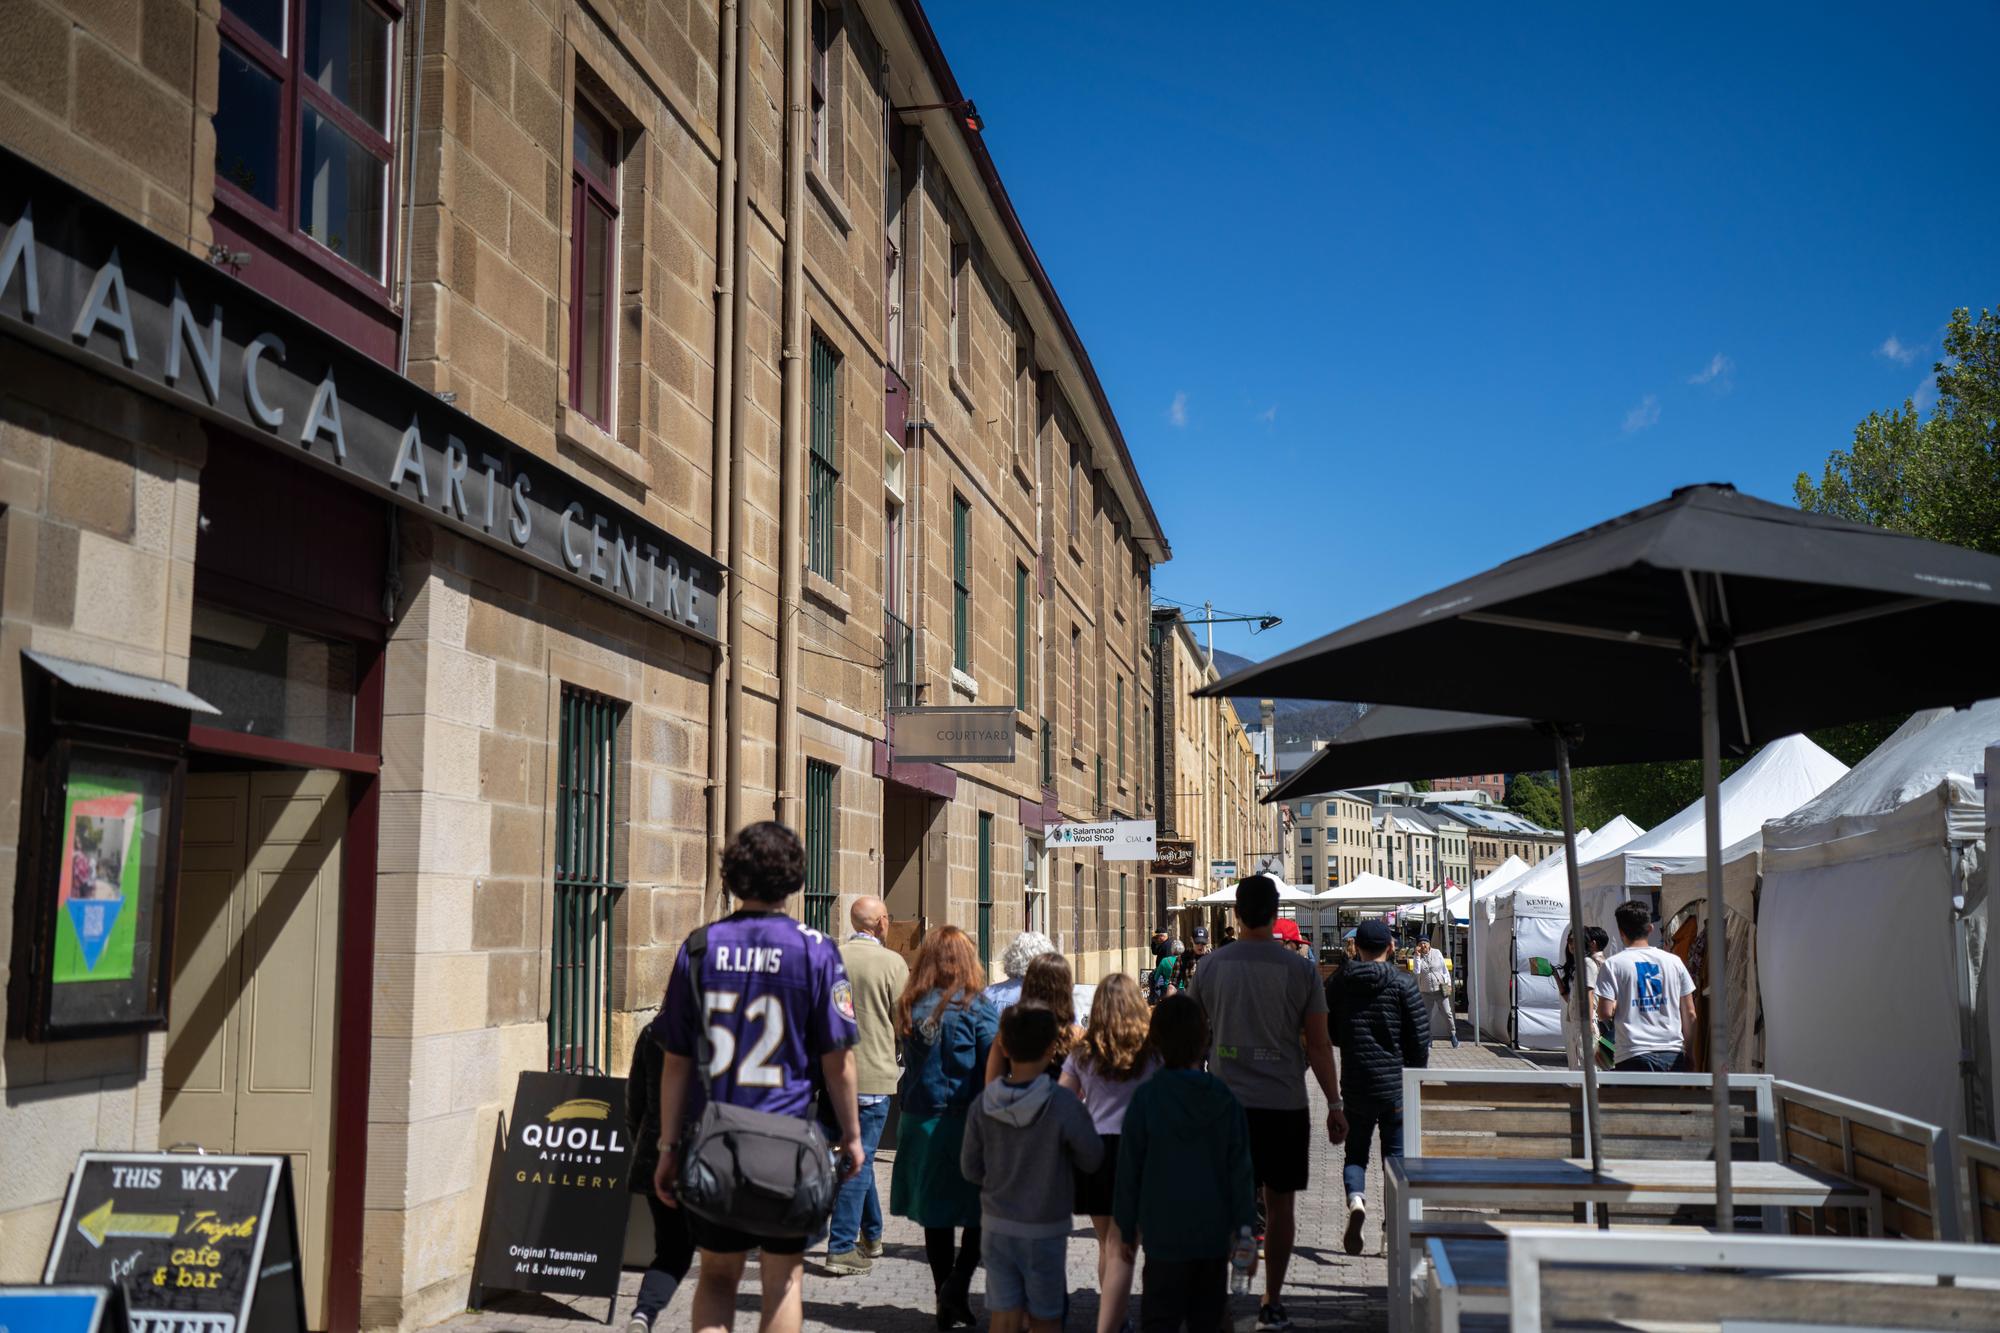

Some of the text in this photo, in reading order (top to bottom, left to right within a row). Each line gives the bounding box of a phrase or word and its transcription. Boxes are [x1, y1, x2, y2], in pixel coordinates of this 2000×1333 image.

[390, 411, 532, 546] ARTS
[559, 501, 700, 627] CENTRE
[936, 730, 1009, 741] COURTYARD
[1073, 827, 1114, 835] Salamanca
[1094, 834, 1114, 843] Shop
[1526, 899, 1564, 908] KEMPTON
[703, 991, 785, 1088] 52
[522, 1124, 625, 1152] QUOLL
[540, 1151, 601, 1164] Artists
[112, 1166, 238, 1191] THIS WAY
[516, 1170, 617, 1189] GALLERY
[509, 1245, 598, 1263] Original Tasmanian
[152, 1266, 222, 1288] & bar
[515, 1262, 586, 1280] Art & Jewellery
